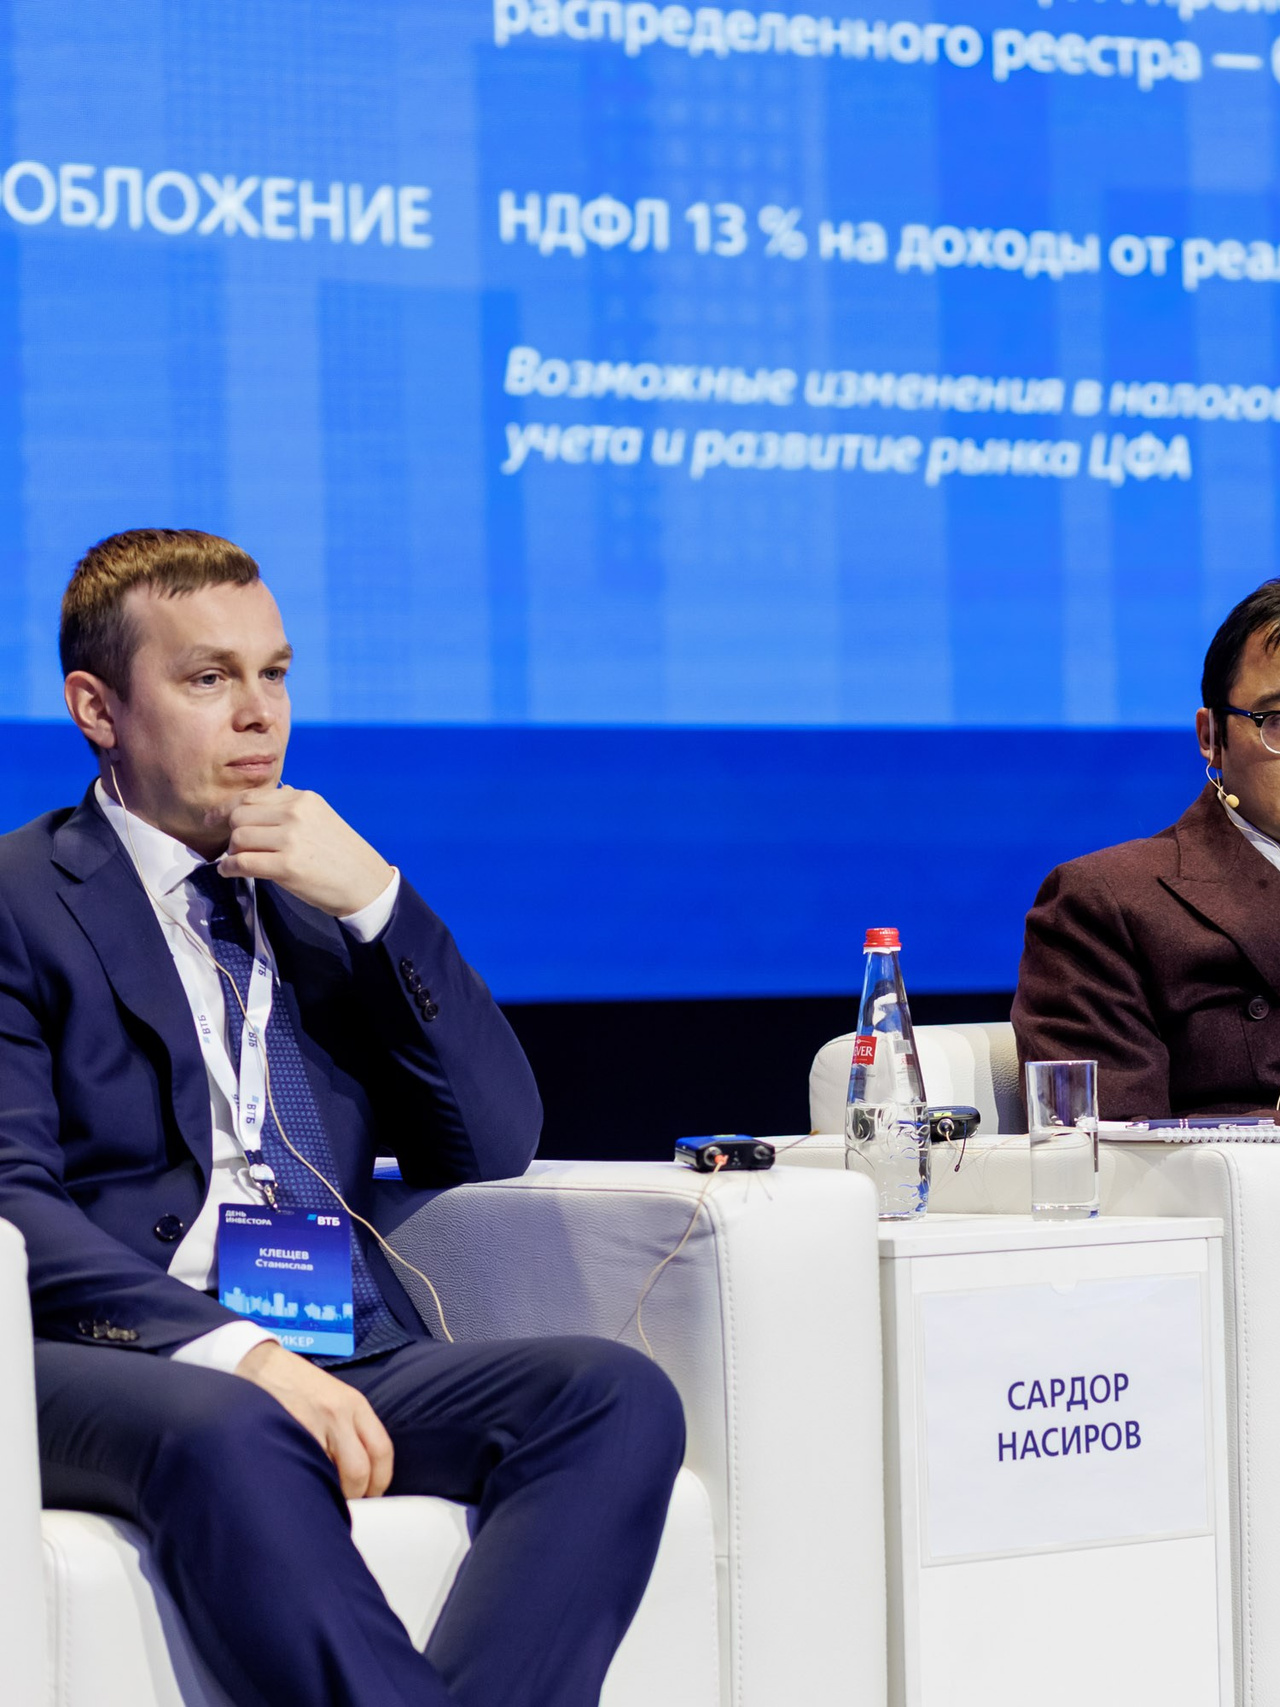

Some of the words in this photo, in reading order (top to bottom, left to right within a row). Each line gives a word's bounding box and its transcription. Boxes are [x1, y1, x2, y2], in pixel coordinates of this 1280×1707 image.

[494, 0, 982, 66] распределенного
[993, 28, 1203, 88] реестра
[2, 160, 433, 249] ОБЛОЖЕНИЕ
[499, 191, 670, 256] НДФЛ
[686, 203, 748, 257] 13
[758, 206, 808, 259] %
[818, 221, 888, 263] на
[896, 224, 1100, 279] доходы
[1110, 235, 1171, 275] от
[505, 346, 798, 406] Возможные
[805, 370, 1065, 413] изменения
[1073, 379, 1102, 416] в
[501, 422, 643, 474] учета
[651, 429, 686, 465] и
[689, 429, 922, 479] развитие
[924, 436, 1081, 486] рынка
[1089, 433, 1192, 486] ЦФА
[197, 1014, 212, 1036] ВТБ
[248, 1031, 258, 1048] ВТБ
[246, 1103, 257, 1125] ВТБ
[225, 1210, 247, 1218] ДЕНЬ
[225, 1217, 272, 1226] ИНВЕСТОРА
[317, 1216, 340, 1226] ВТБ
[255, 1259, 314, 1271] Станислав
[259, 1248, 310, 1260] КЛЕЩЕВ
[1007, 1373, 1129, 1413] САРДОР
[998, 1420, 1142, 1462] НАСИРОВ
